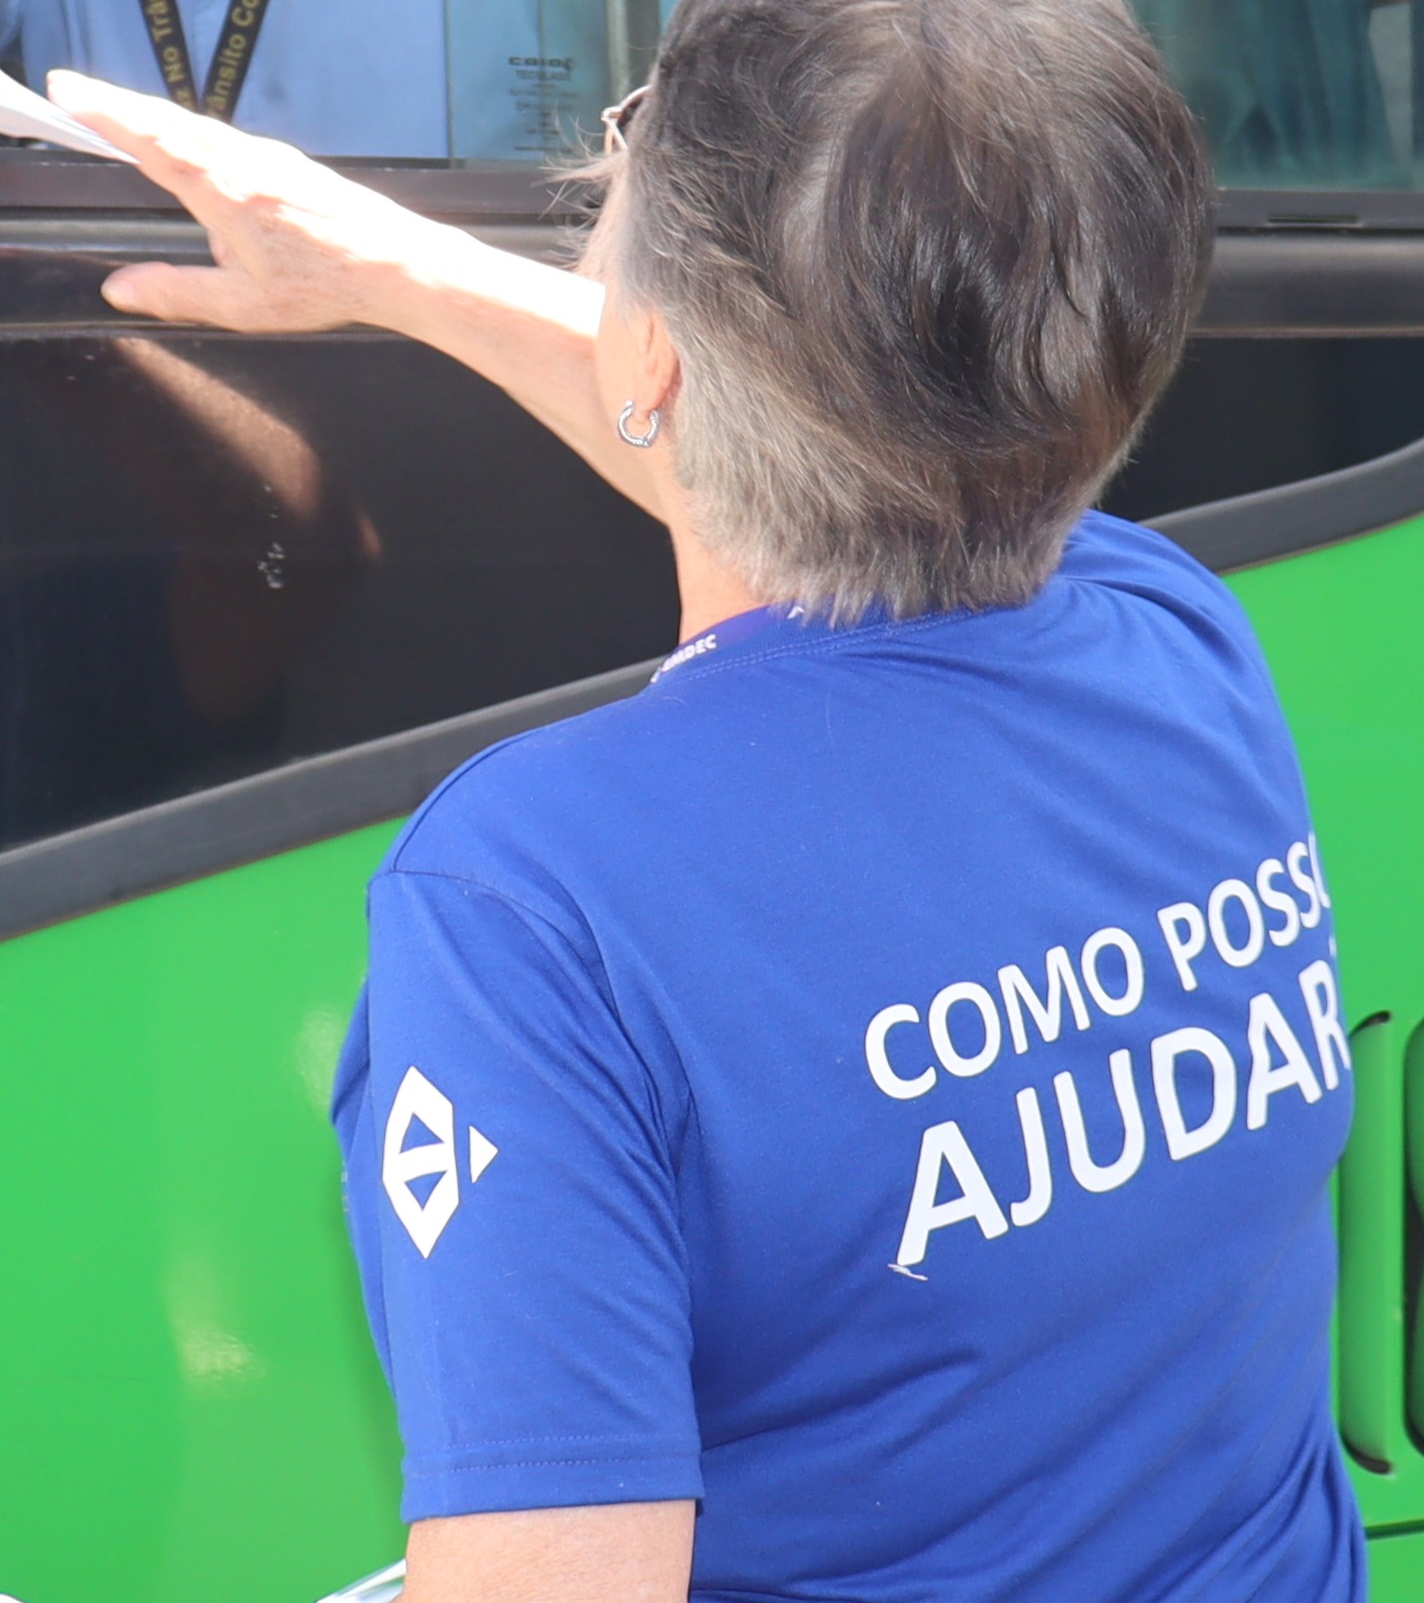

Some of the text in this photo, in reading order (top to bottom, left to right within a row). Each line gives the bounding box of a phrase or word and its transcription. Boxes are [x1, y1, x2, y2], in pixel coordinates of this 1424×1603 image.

[163, 48, 186, 84] No
[863, 926, 1145, 1101] COMO
[895, 959, 1352, 1266] AJUDAR
